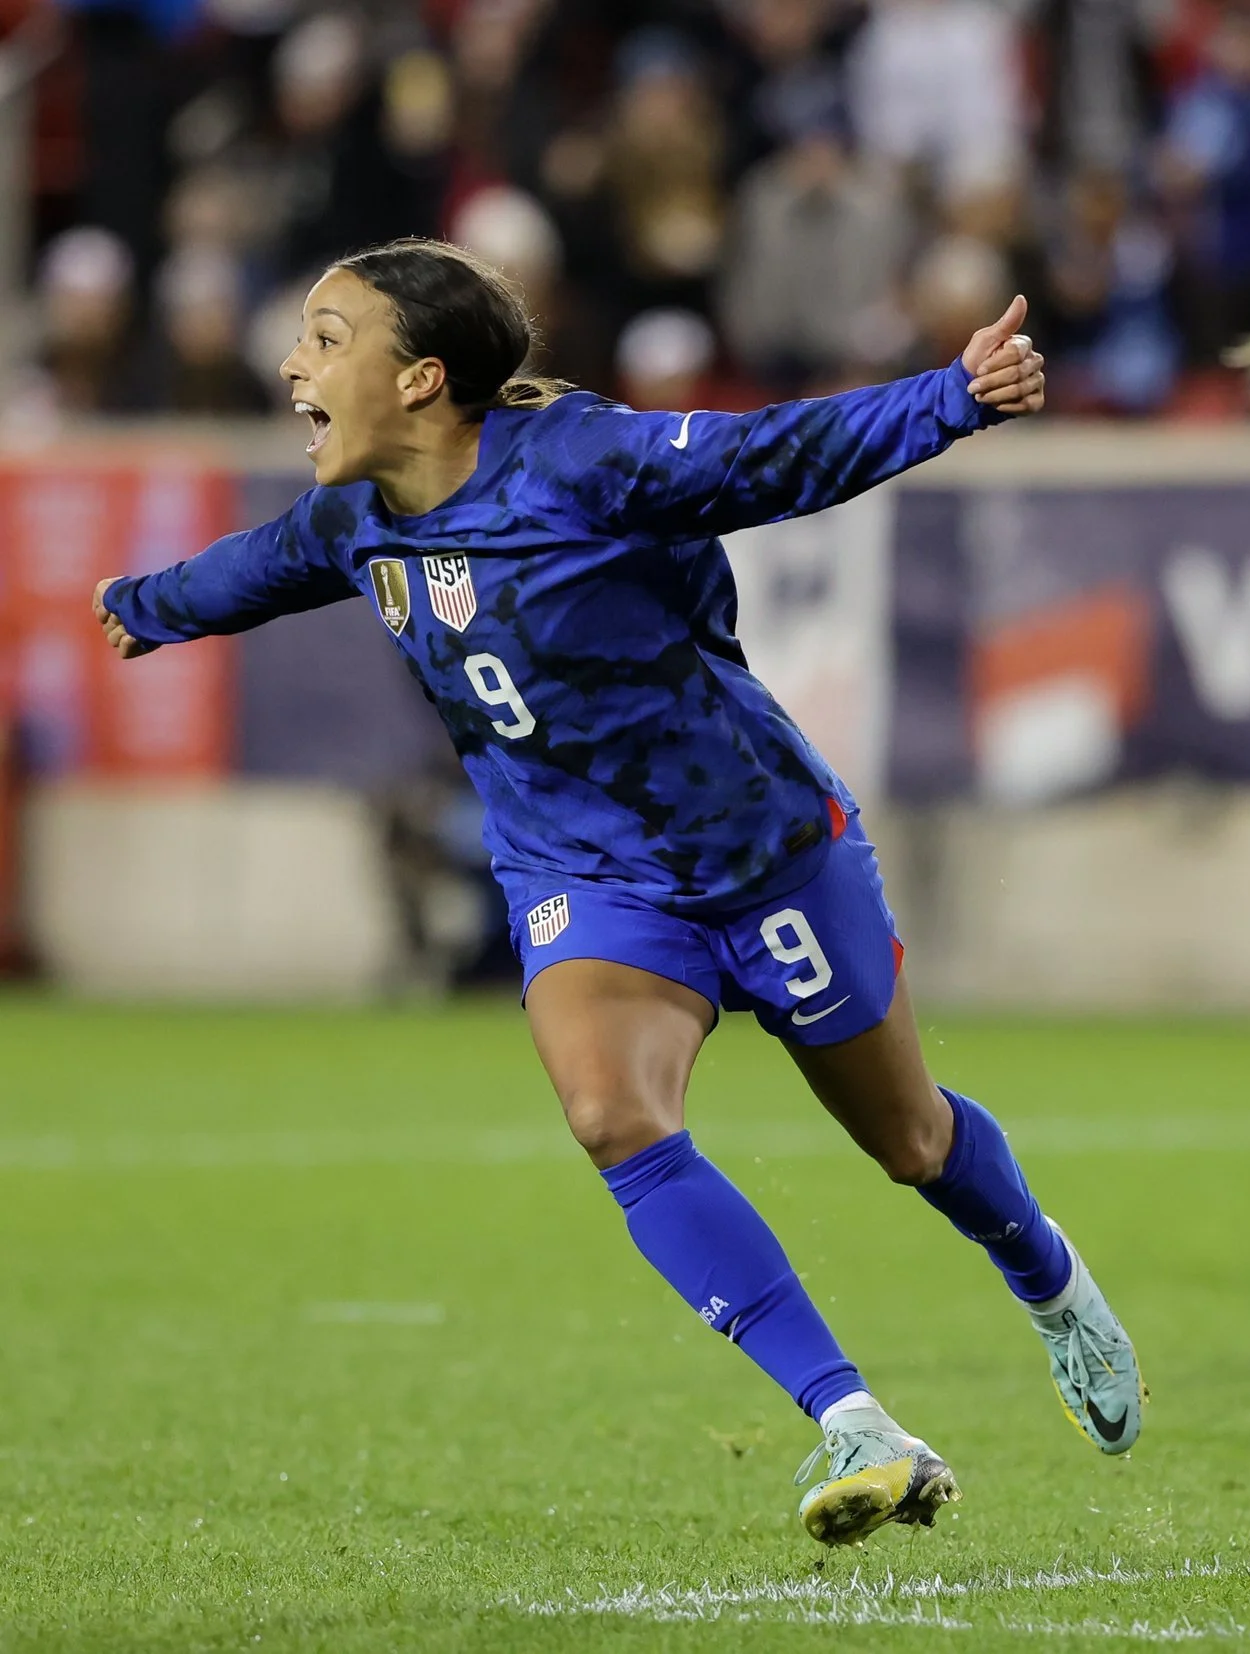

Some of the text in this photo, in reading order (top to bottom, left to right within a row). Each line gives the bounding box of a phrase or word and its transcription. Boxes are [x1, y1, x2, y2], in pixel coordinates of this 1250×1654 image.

[426, 554, 467, 587] USA
[463, 652, 537, 740] 9
[530, 896, 564, 925] USA
[758, 907, 833, 999] 9
